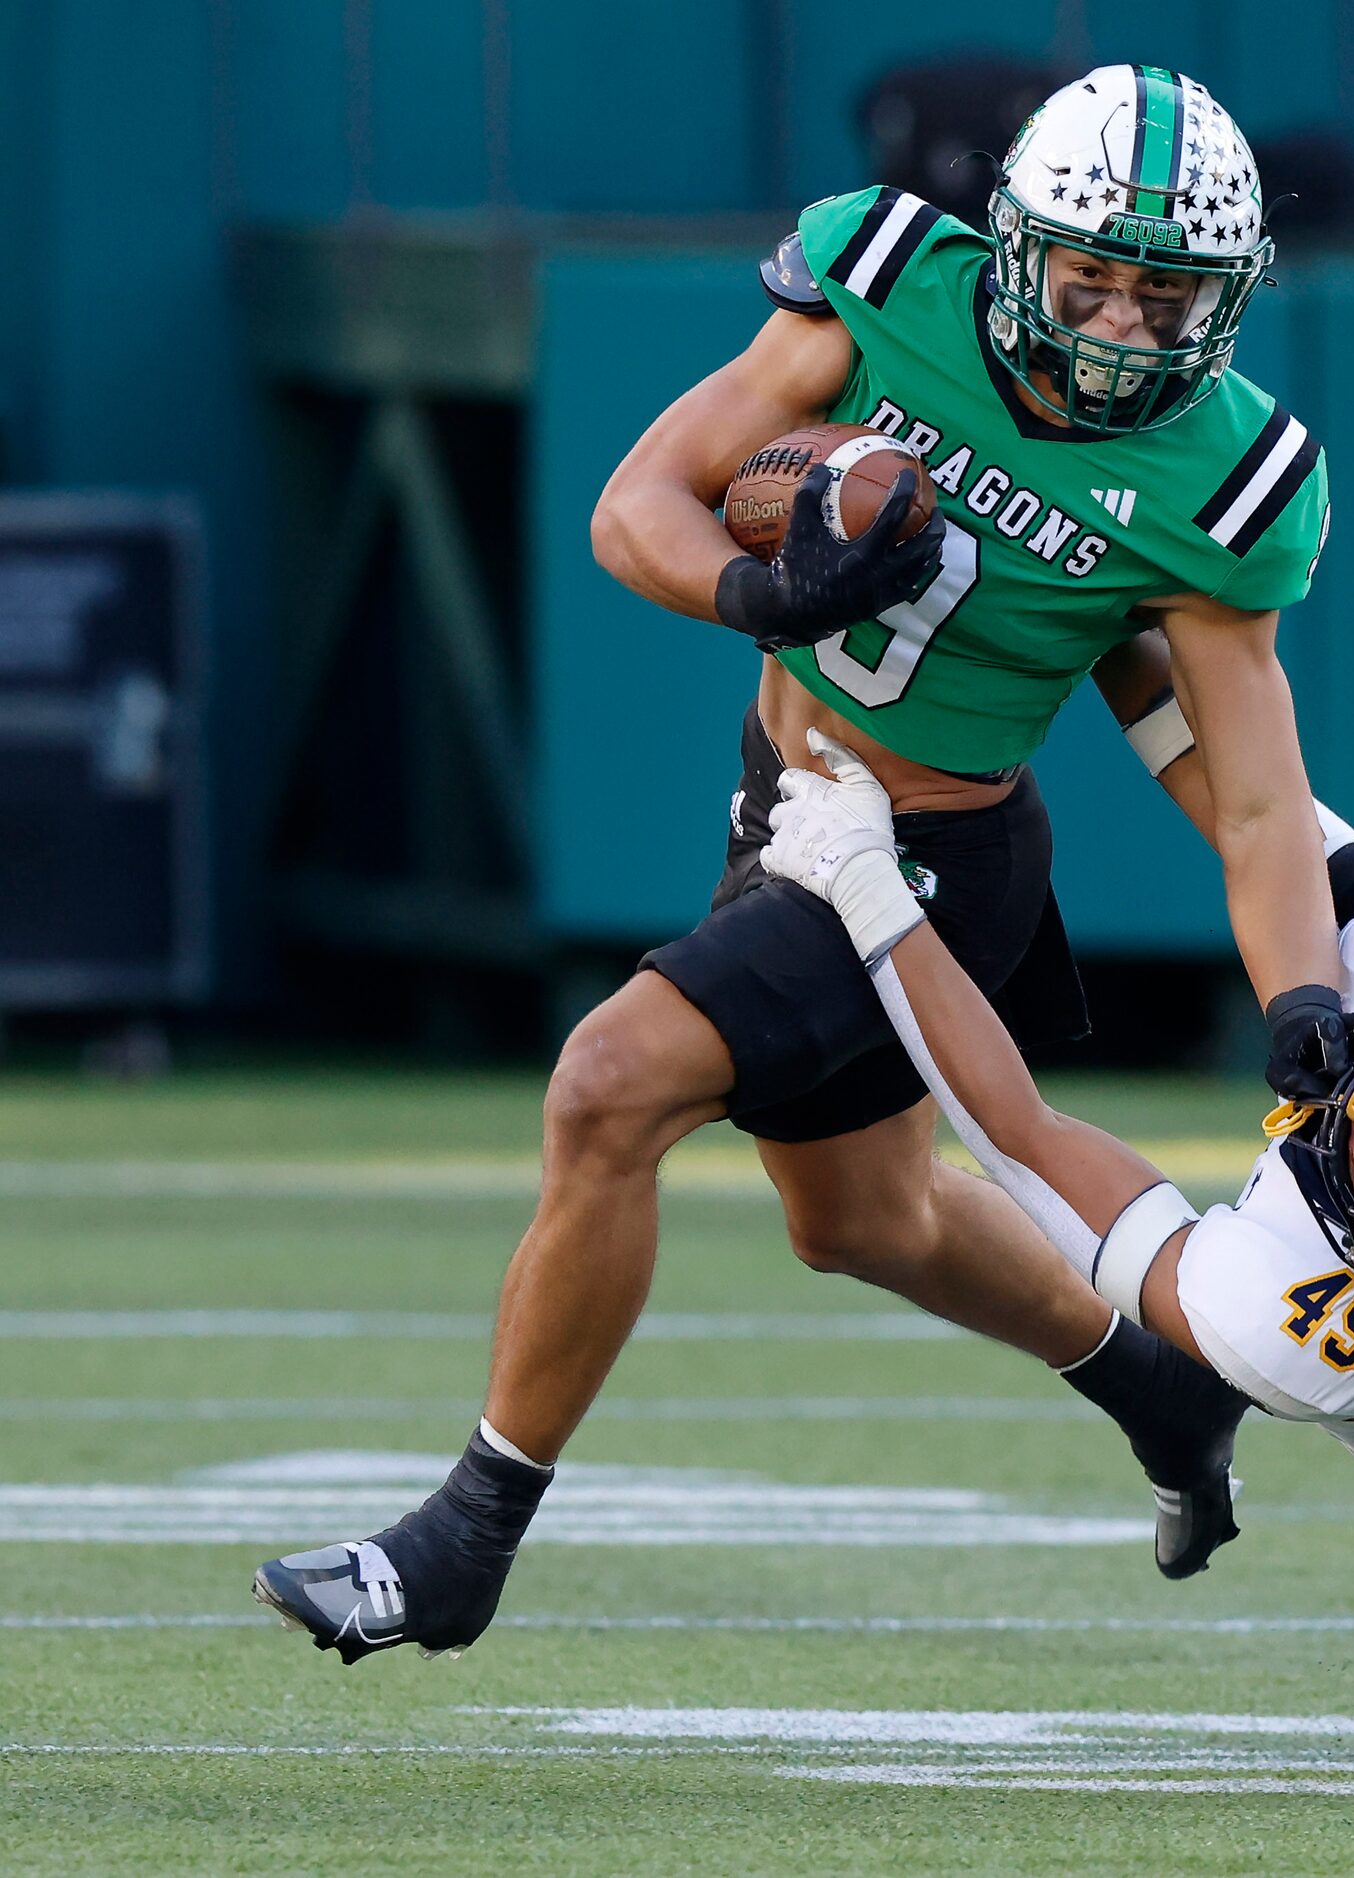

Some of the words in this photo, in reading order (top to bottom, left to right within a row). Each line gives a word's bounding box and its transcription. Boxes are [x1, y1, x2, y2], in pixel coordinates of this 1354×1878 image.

[1108, 214, 1183, 247] 76092
[863, 395, 1111, 579] DRAGONS
[731, 497, 786, 523] Wilson
